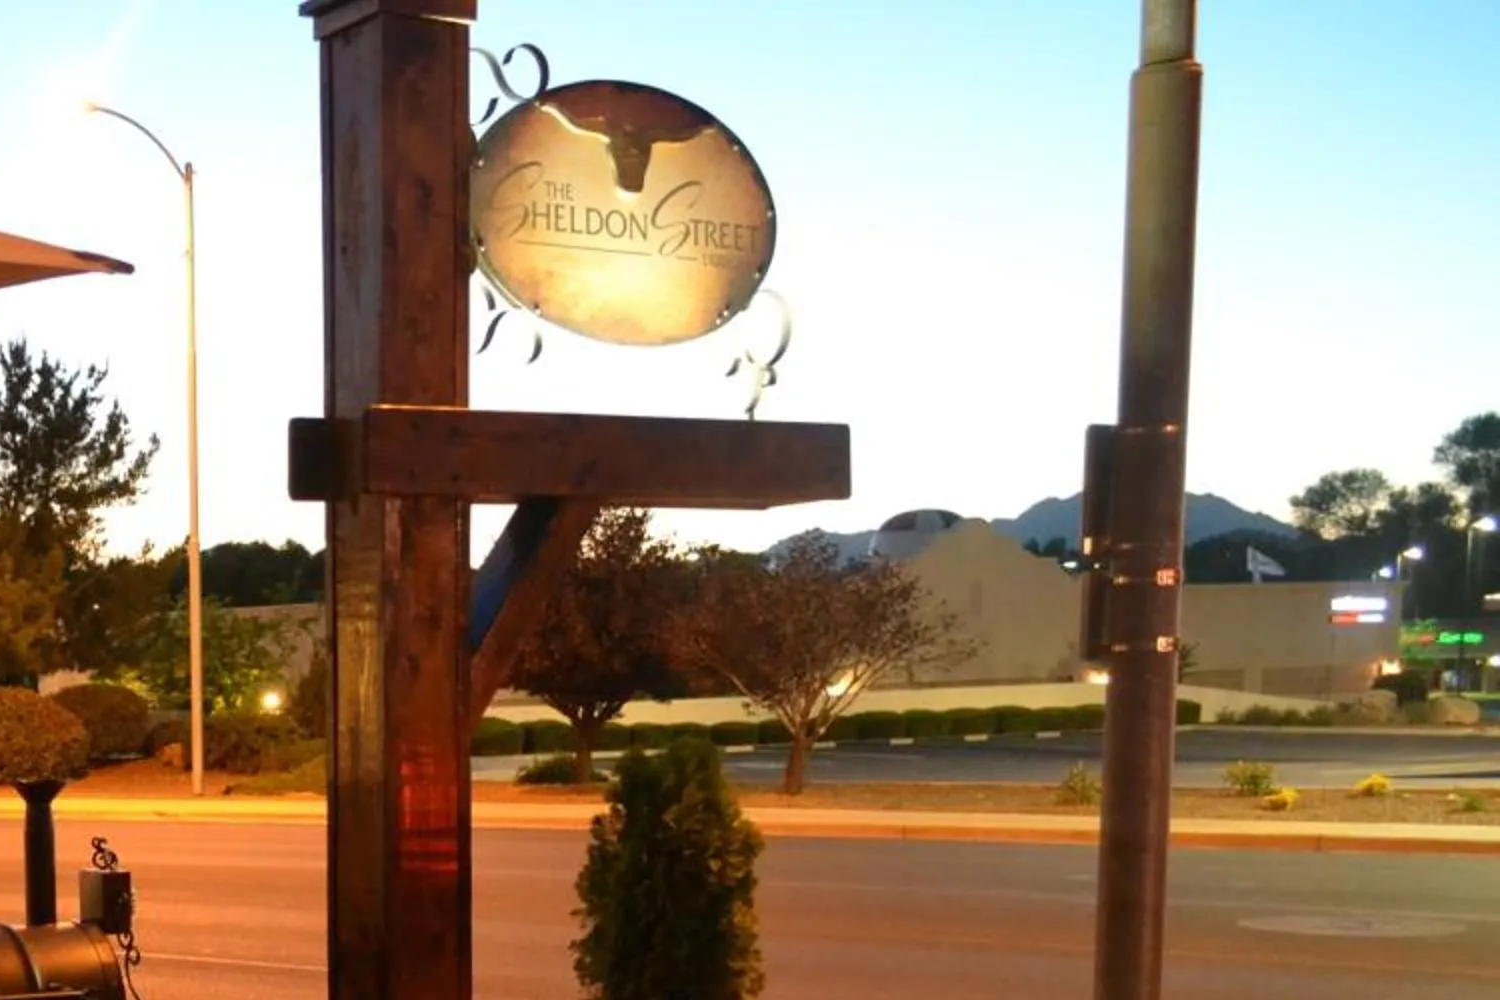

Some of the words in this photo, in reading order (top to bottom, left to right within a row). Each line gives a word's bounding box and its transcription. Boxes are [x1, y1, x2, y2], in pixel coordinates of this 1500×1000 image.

[490, 161, 648, 240] SHELDON
[650, 180, 759, 256] STREET
[543, 180, 575, 202] THE
